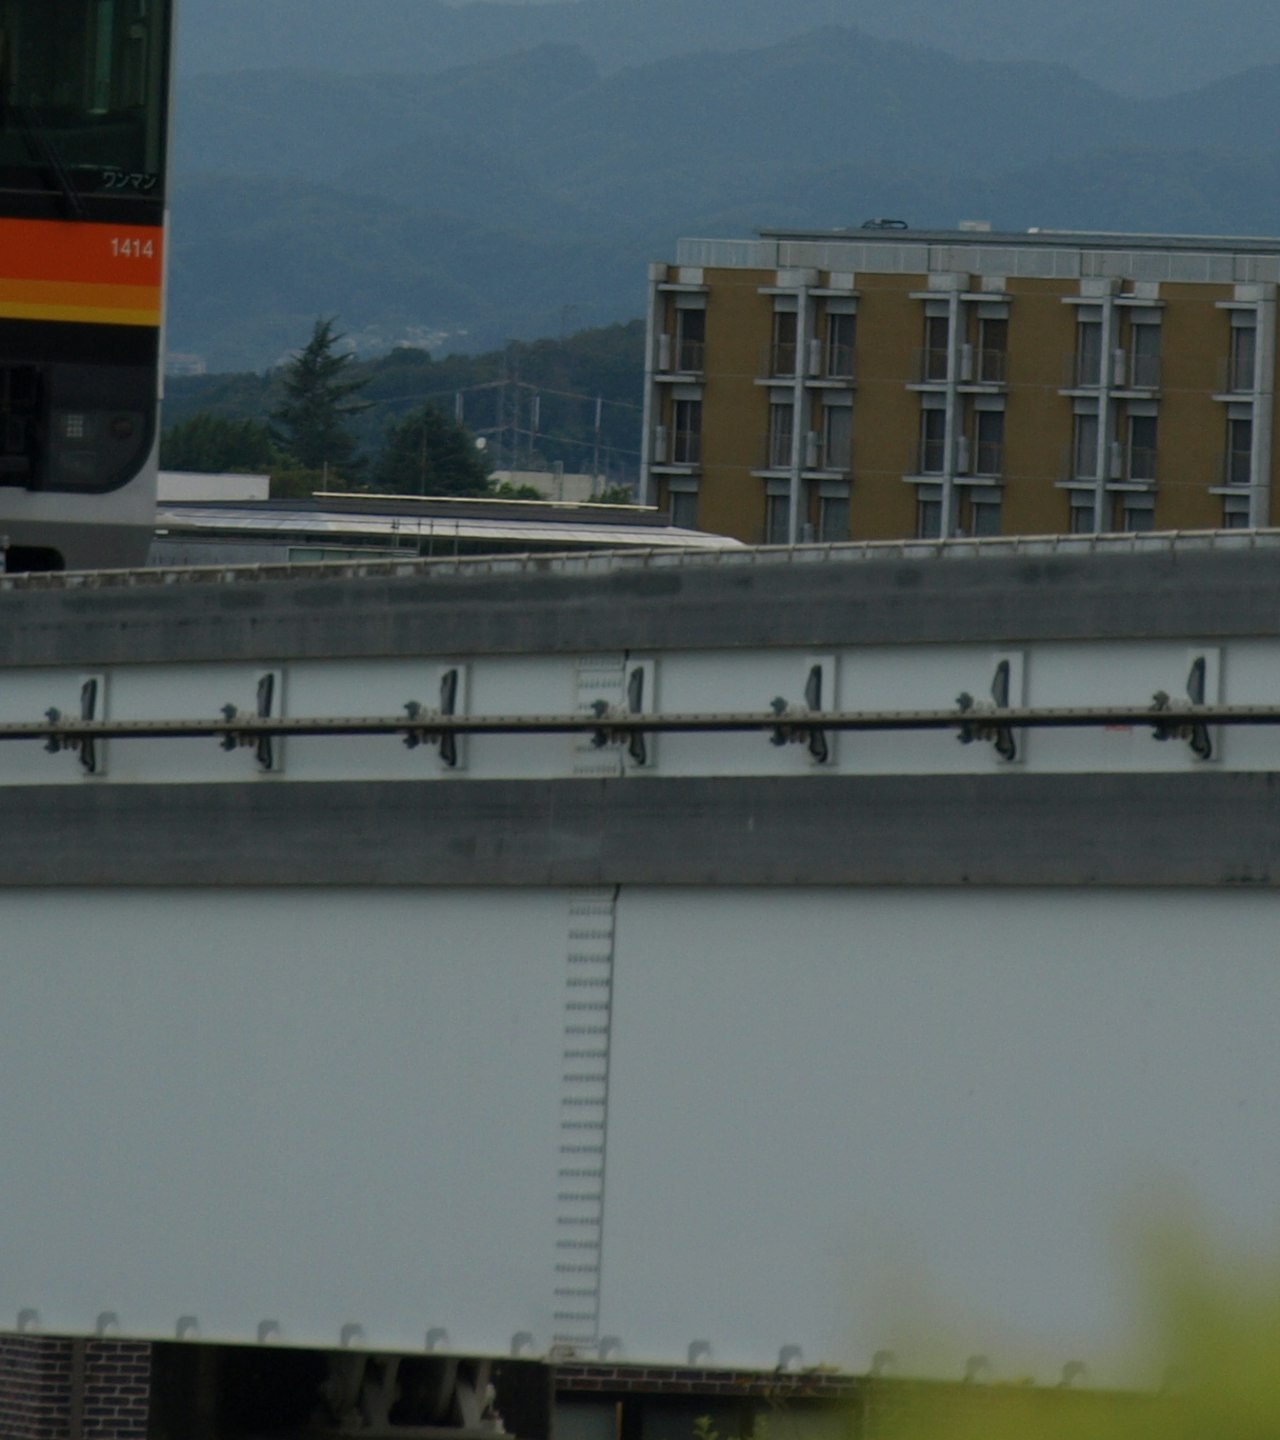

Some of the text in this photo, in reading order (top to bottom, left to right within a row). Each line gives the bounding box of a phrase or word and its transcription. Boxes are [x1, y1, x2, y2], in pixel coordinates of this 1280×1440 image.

[103, 171, 157, 190] ワンマン
[111, 237, 154, 259] 1414
